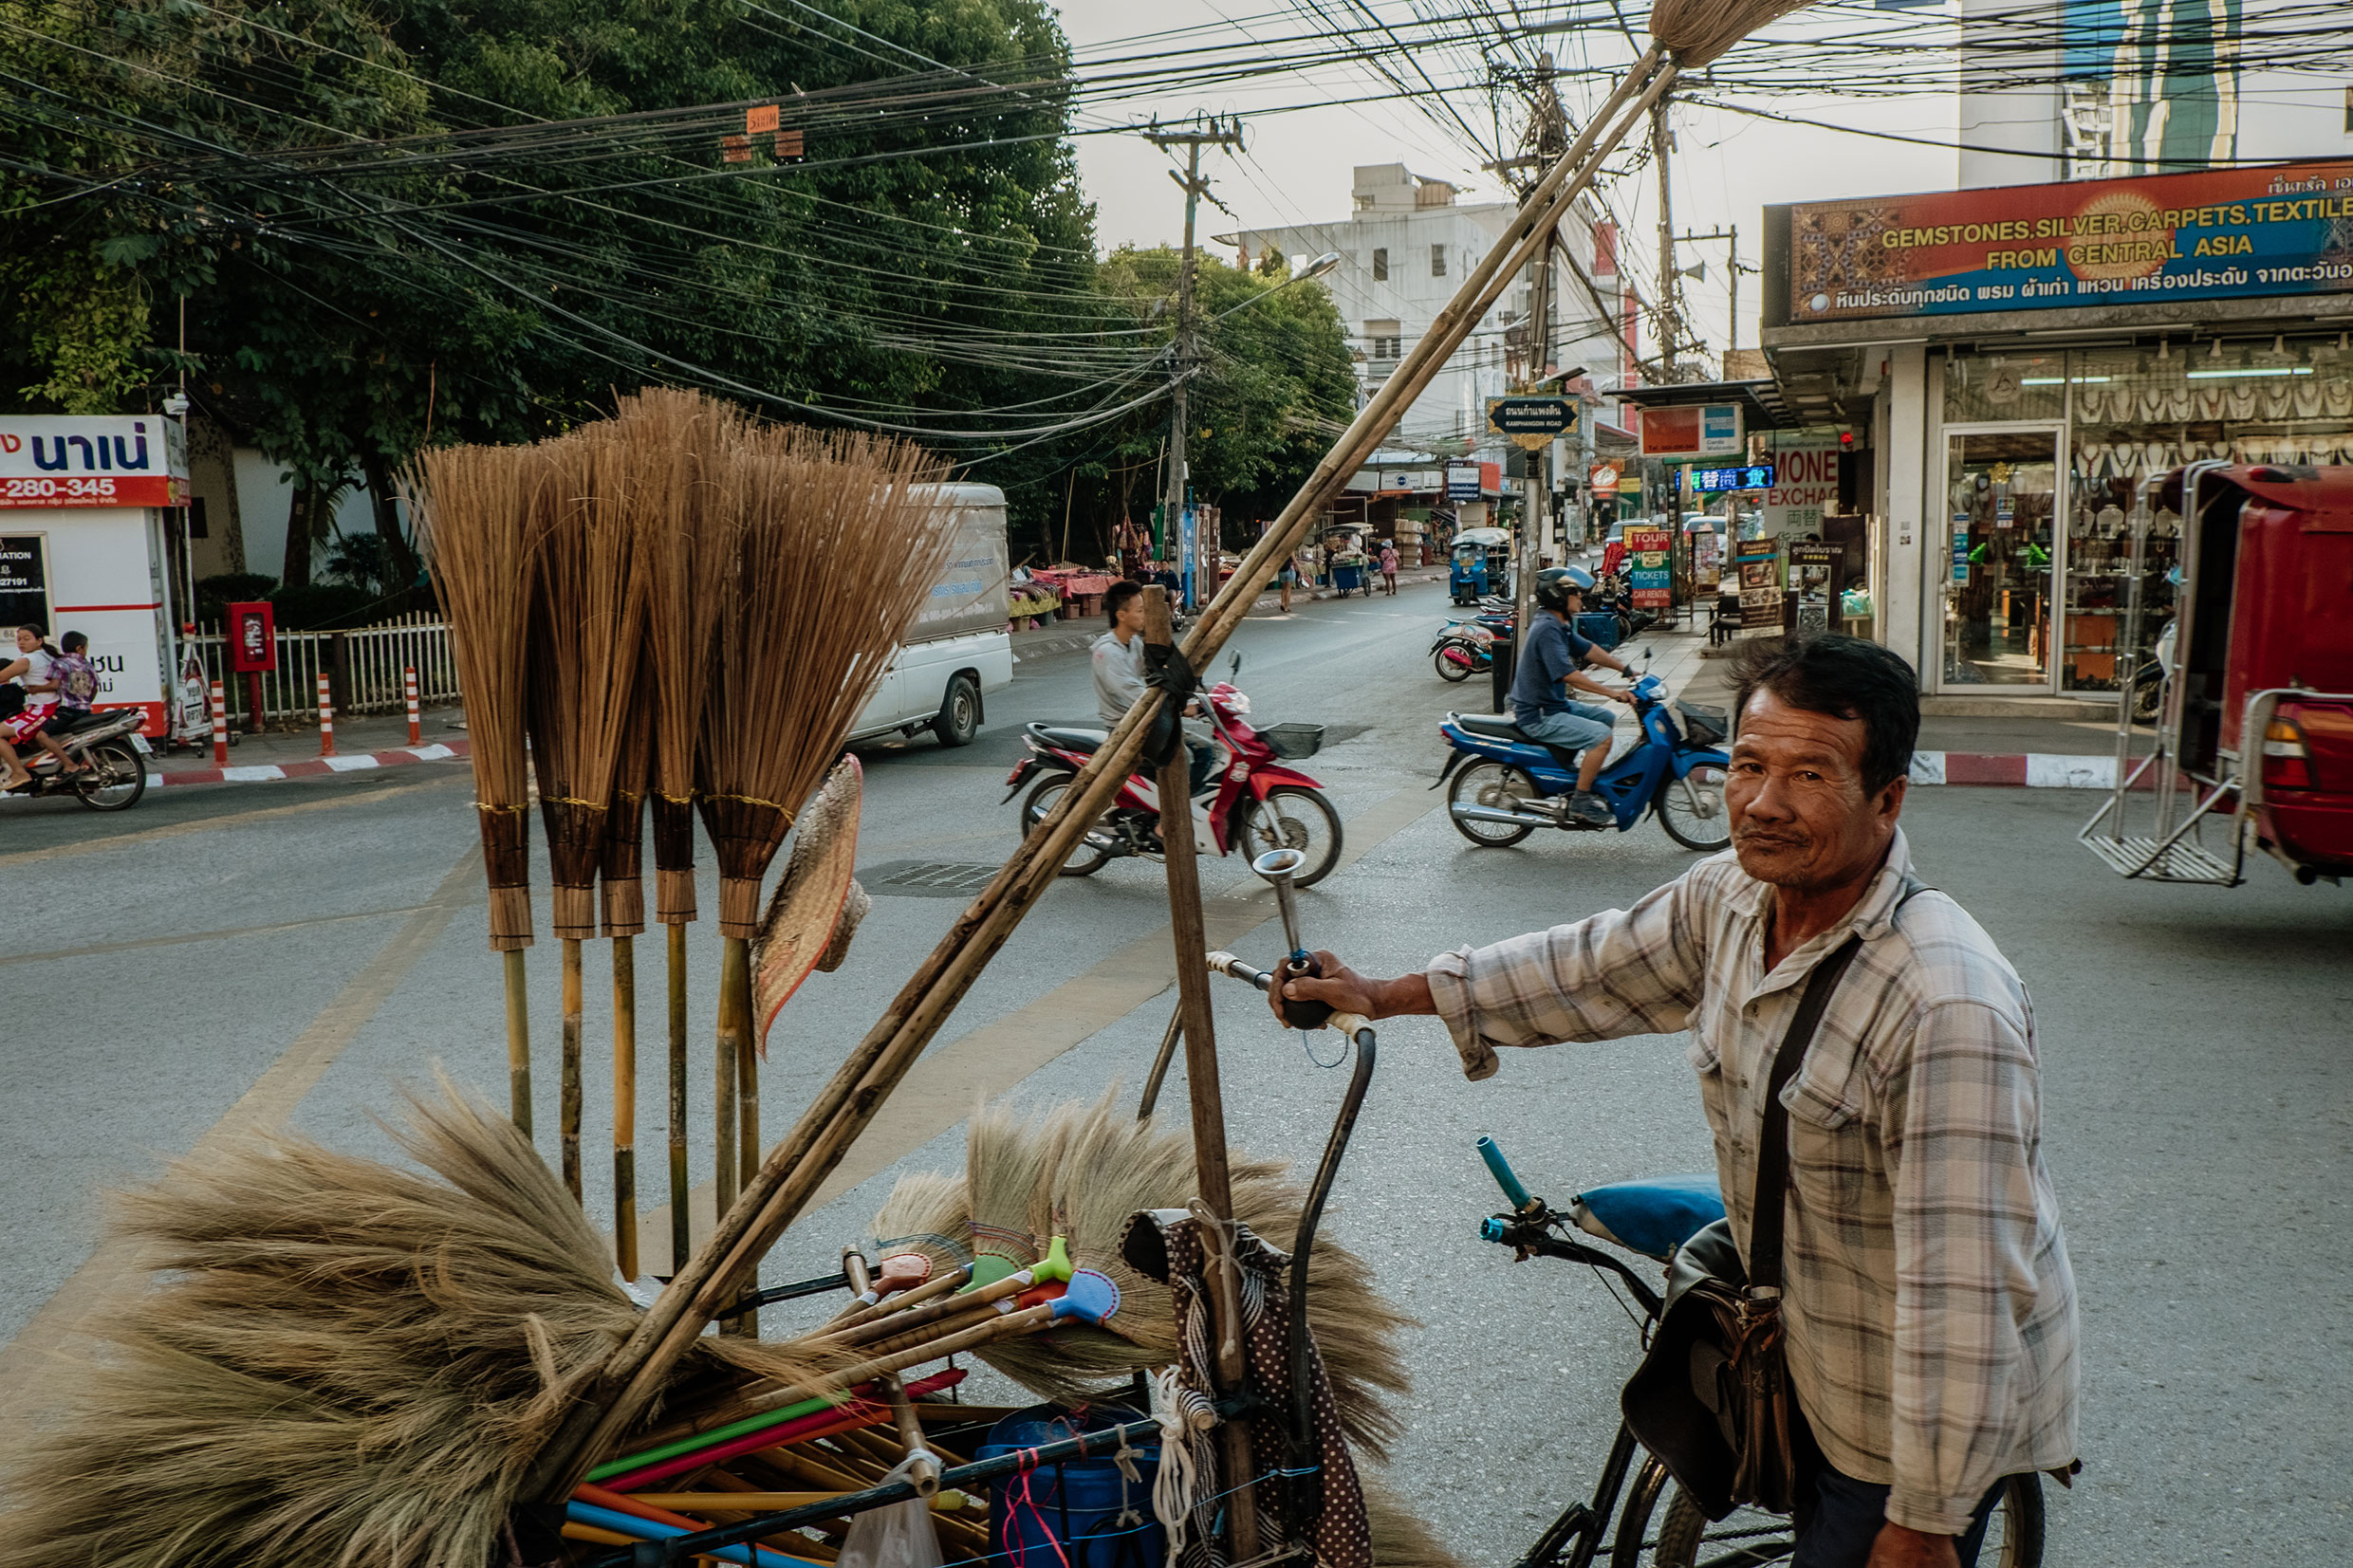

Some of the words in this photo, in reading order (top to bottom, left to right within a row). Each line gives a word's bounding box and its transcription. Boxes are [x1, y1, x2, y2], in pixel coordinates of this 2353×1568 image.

[2269, 173, 2327, 194] เซ็นทรัล
[2335, 176, 2353, 190] เอ
[1987, 249, 2058, 270] FROM
[2067, 240, 2184, 266] CENTRAL
[2194, 234, 2254, 257] ASIA
[1836, 285, 1971, 308] หินประดับทุกชนิด
[1977, 284, 2014, 301] พรม
[2021, 277, 2069, 298] ผ้าเก่า
[2077, 278, 2124, 294] แหวน
[2132, 266, 2248, 291] เครื่องประดับ
[1505, 404, 1562, 416] ถนนกำแพงดิน
[31, 421, 149, 471] นาเน่
[1634, 533, 1668, 543] TOUR
[1792, 544, 1843, 555] ลูกปัดโบราณ
[1635, 571, 1669, 580] TICKETS
[1634, 590, 1646, 599] CAR
[1647, 589, 1670, 599] RENTAL
